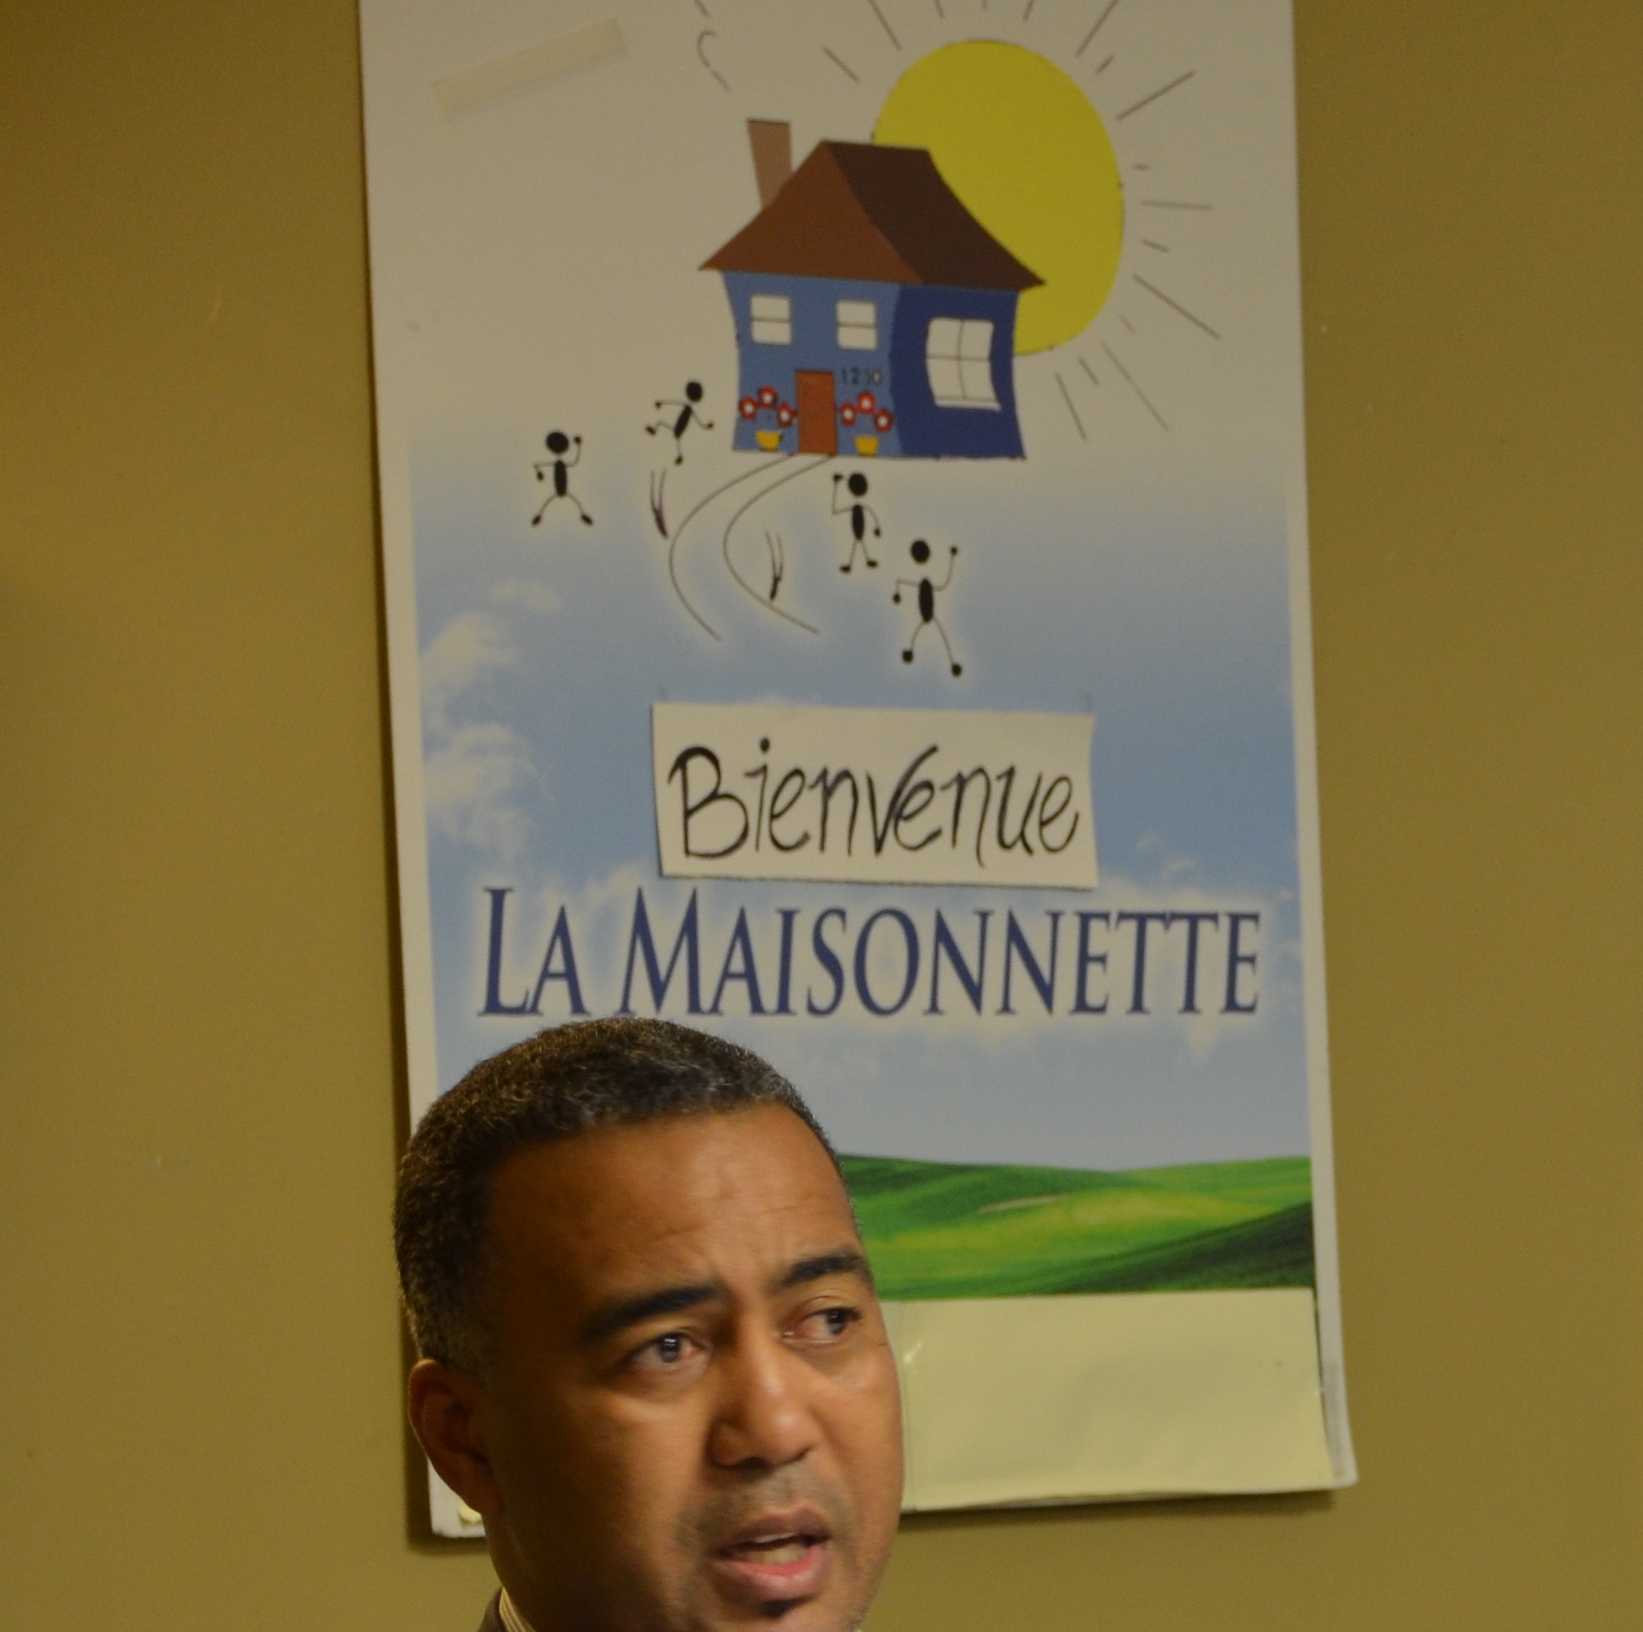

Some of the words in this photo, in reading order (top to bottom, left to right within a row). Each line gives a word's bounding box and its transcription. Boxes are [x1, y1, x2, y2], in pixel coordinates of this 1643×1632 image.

[667, 738, 1080, 868] Bienvenue
[478, 886, 592, 1016] LA
[612, 886, 1262, 1018] MAISONNETTE
